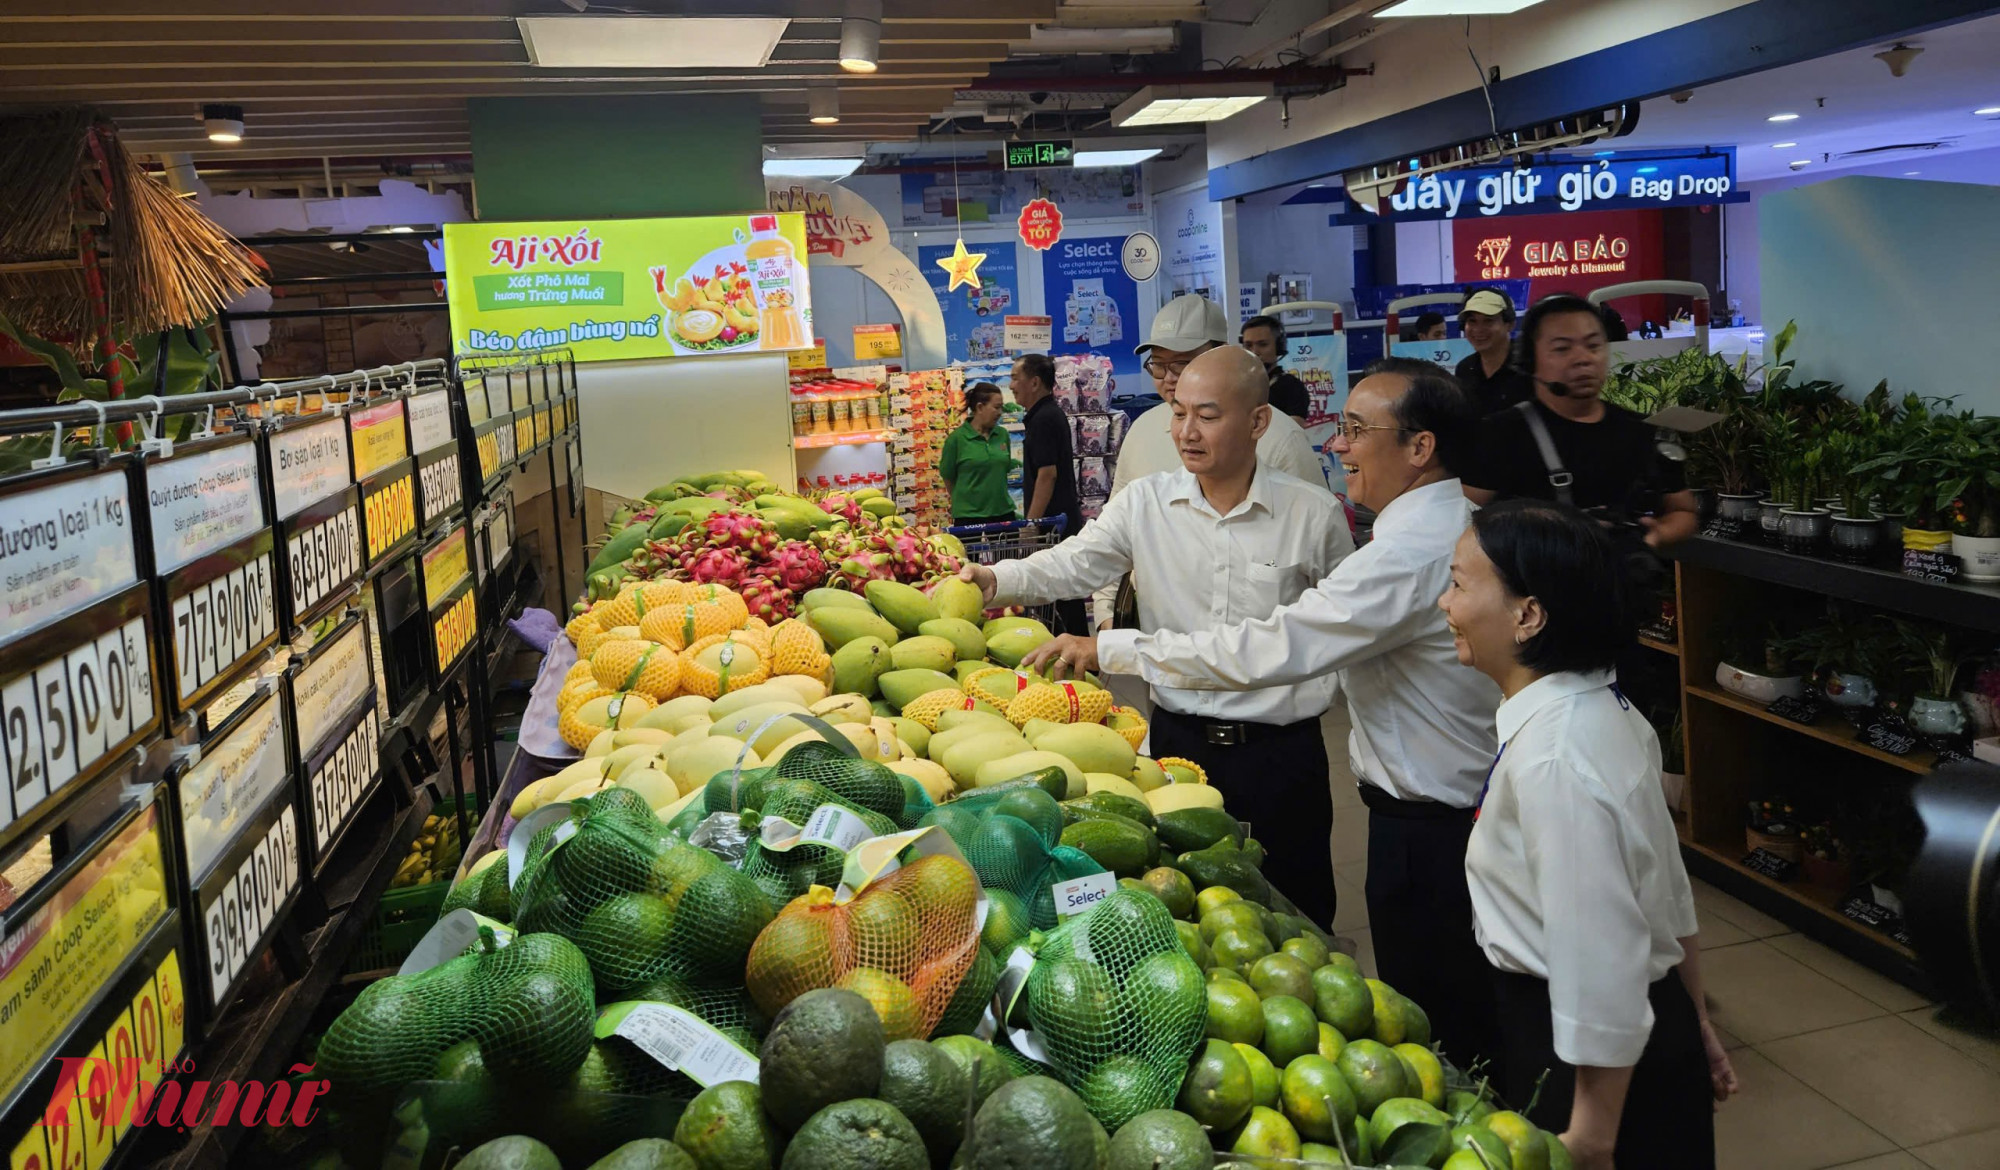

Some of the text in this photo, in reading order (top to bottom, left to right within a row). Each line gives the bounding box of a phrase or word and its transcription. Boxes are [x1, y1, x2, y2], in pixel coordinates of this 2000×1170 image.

[1010, 154, 1033, 165] EXIT
[770, 186, 833, 218] NĂM
[1478, 168, 1542, 216] giữ
[1559, 159, 1618, 212] giỏ
[1631, 177, 1673, 201] Bag
[1679, 174, 1731, 198] Drop
[1032, 207, 1048, 218] GIÁ
[1028, 225, 1052, 240] TỐT
[1064, 242, 1113, 258] Select
[1524, 234, 1630, 264] GIA BẢO
[508, 274, 590, 289] Xốt Phô Mai
[1528, 261, 1626, 278] Jewelry & Diamond
[528, 288, 569, 303] Trứng
[571, 287, 605, 300] Muối
[1078, 290, 1099, 298] Select
[470, 314, 661, 351] Béo đậm bùng nổ
[1302, 367, 1332, 383] NĂM
[280, 449, 292, 470] Bơ
[325, 436, 329, 456] 1
[330, 434, 339, 458] kg
[151, 486, 171, 508] Quýt
[173, 482, 198, 499] đường
[199, 477, 216, 494] Coop
[217, 469, 235, 487] Select
[59, 502, 90, 540] loại
[93, 498, 101, 526] 1
[105, 496, 124, 527] kg
[292, 522, 347, 602] 83.500
[178, 572, 259, 677] 77.900
[9, 650, 125, 792] 2.500
[315, 735, 367, 833] 57.500
[811, 808, 828, 838] Select
[211, 836, 283, 976] 39.900
[1067, 887, 1106, 908] Select
[24, 956, 53, 999] sành
[53, 924, 84, 963] Coop
[83, 888, 116, 931] Select
